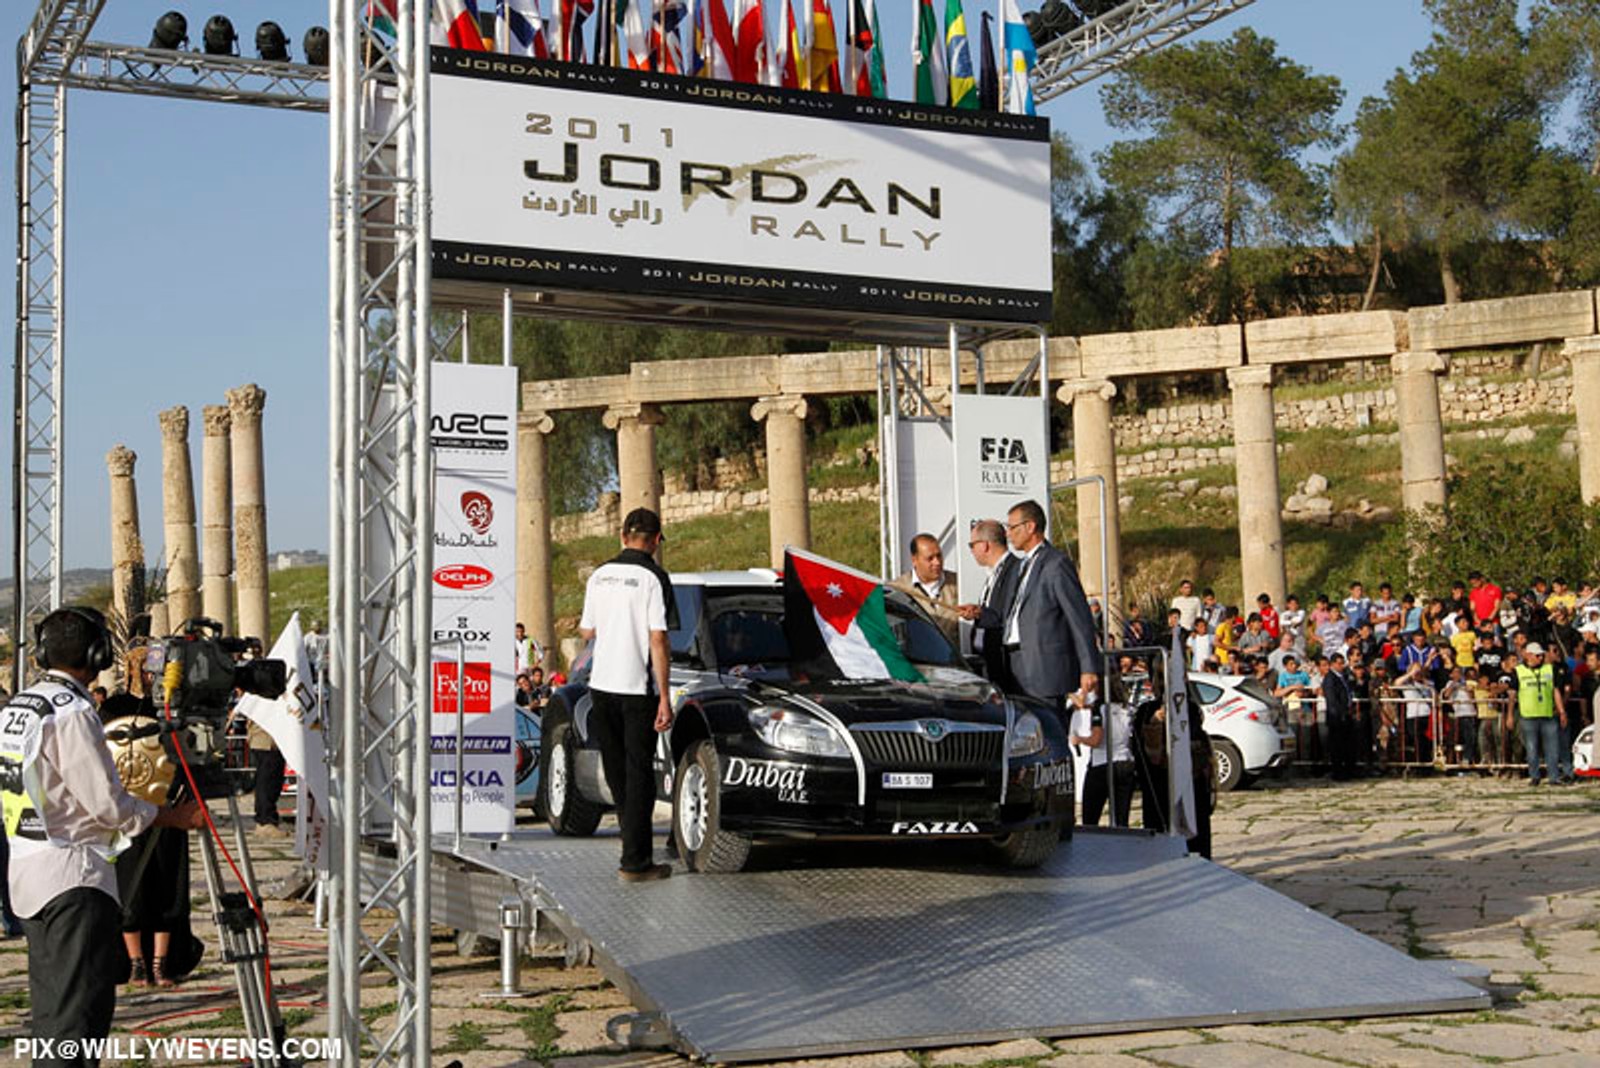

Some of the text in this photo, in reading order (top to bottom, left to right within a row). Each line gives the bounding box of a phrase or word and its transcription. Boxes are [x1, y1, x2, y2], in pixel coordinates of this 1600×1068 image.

[456, 57, 560, 79] JORDAN
[567, 72, 616, 84] RALLY
[639, 79, 680, 92] 2011
[686, 84, 782, 104] JORDAN
[788, 97, 834, 109] RALLY
[855, 104, 893, 116] 2011
[898, 109, 988, 128] JORDAN
[525, 112, 674, 148] 2011
[523, 142, 942, 220] JORDAN
[522, 189, 663, 228] رالي الأردن
[750, 215, 942, 251] RALLY
[455, 251, 561, 271] JORDAN
[568, 263, 618, 274] RALLY
[642, 268, 683, 279] 2011
[689, 271, 786, 289] JORDAN
[791, 281, 838, 292] RALLY
[859, 285, 898, 296] 2011
[902, 289, 992, 306] JORDAN
[997, 299, 1040, 309] RALLY
[440, 571, 488, 582] DELPHI
[433, 630, 491, 641] EDOX
[722, 756, 808, 790] Dubai
[472, 790, 505, 804] People
[891, 821, 979, 834] FAZZA
